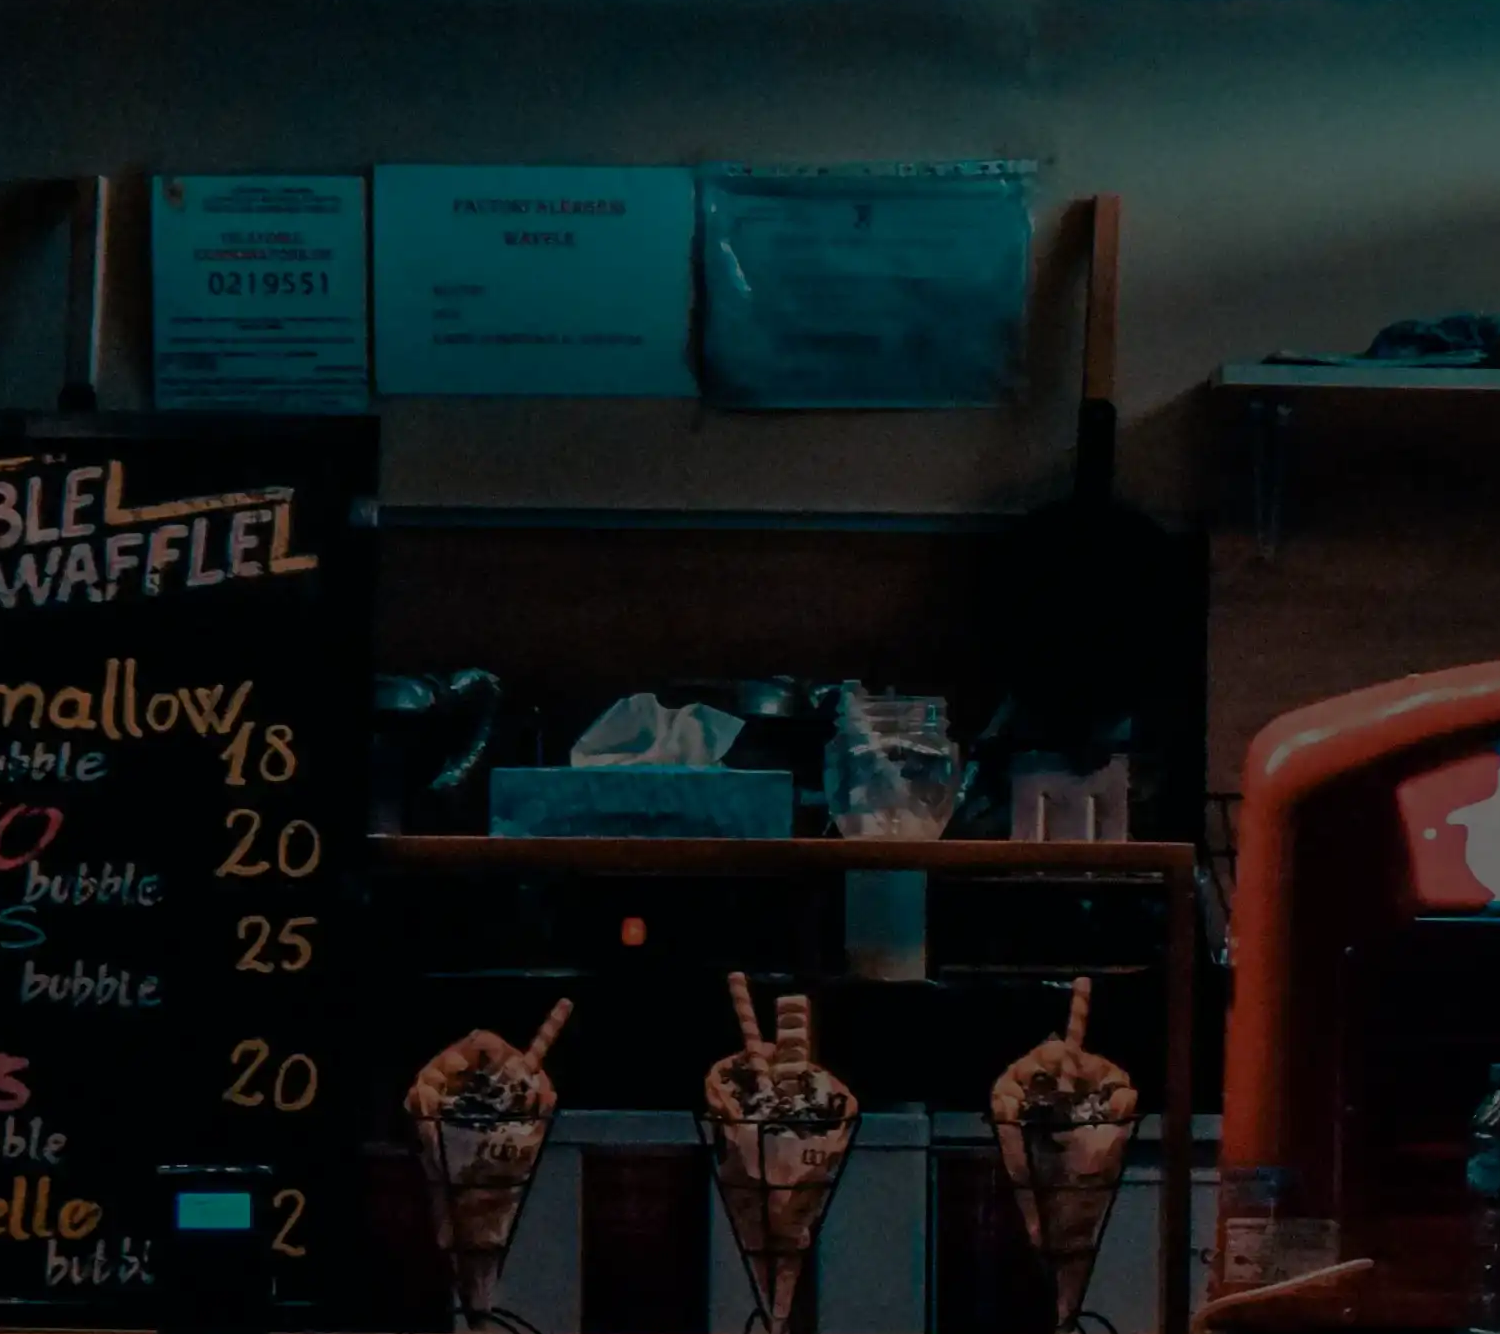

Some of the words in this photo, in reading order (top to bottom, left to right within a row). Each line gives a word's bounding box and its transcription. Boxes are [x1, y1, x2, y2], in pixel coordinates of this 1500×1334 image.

[207, 270, 330, 297] 0219551
[217, 721, 298, 786] 18
[212, 807, 323, 879] 20
[22, 859, 167, 908] bubble
[234, 912, 319, 975] 25
[19, 958, 165, 1010] bubble
[221, 1036, 320, 1114] 20
[271, 1187, 308, 1259] 2
